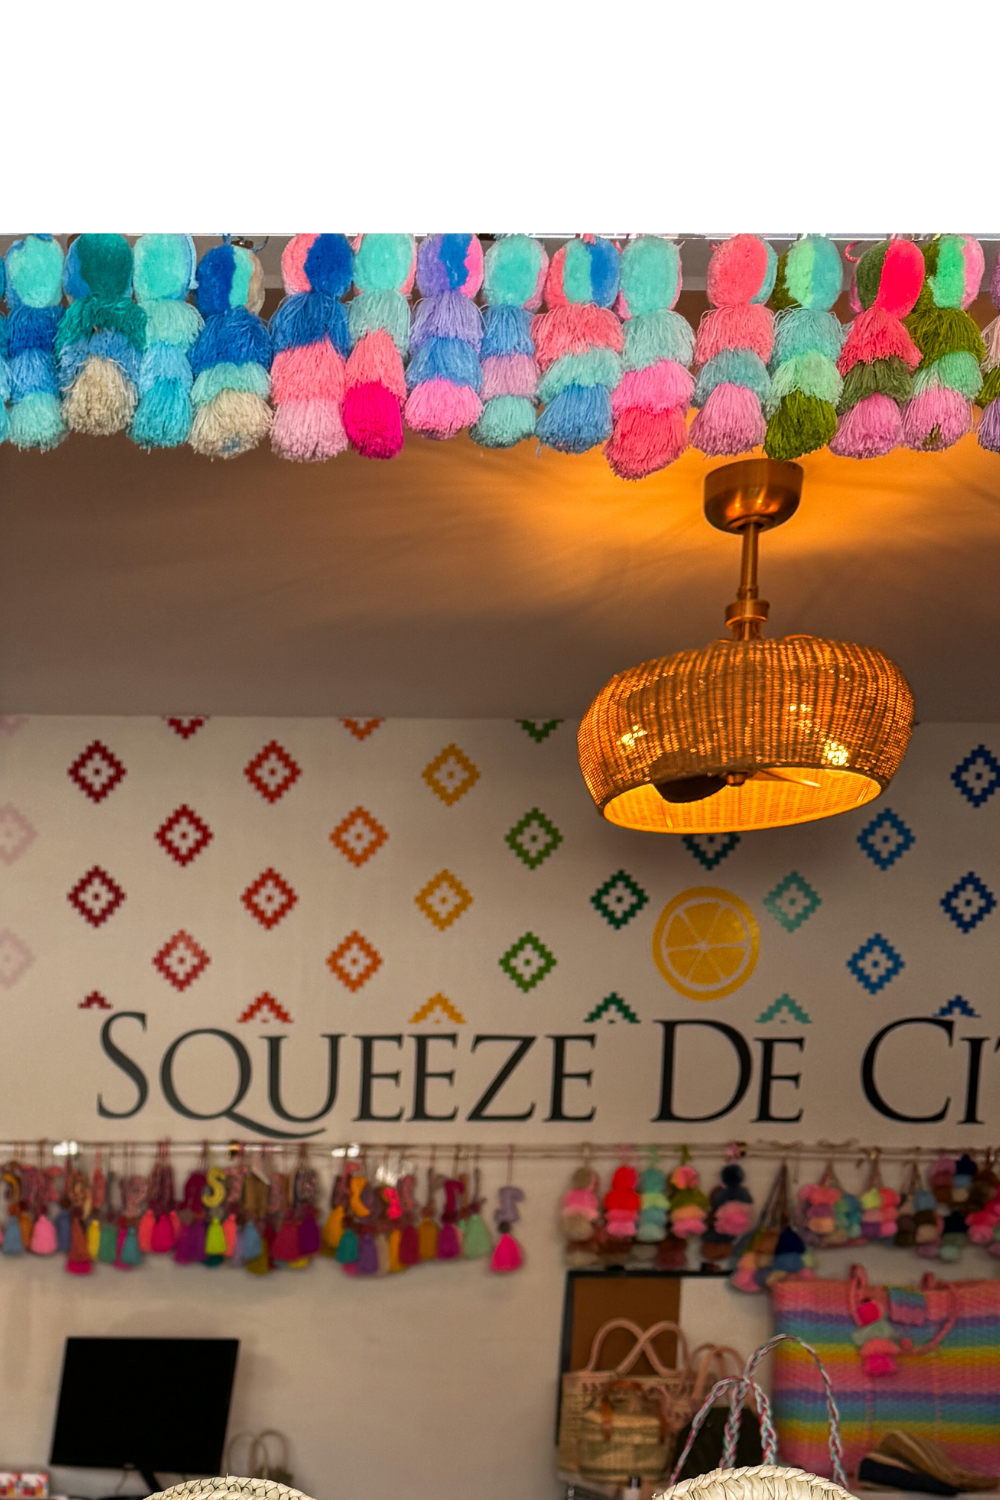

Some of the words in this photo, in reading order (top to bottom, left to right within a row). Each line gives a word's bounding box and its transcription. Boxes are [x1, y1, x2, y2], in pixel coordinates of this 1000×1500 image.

[96, 1011, 597, 1139] SQUEEZE
[651, 1019, 805, 1124] DE
[860, 1016, 1000, 1125] CI
